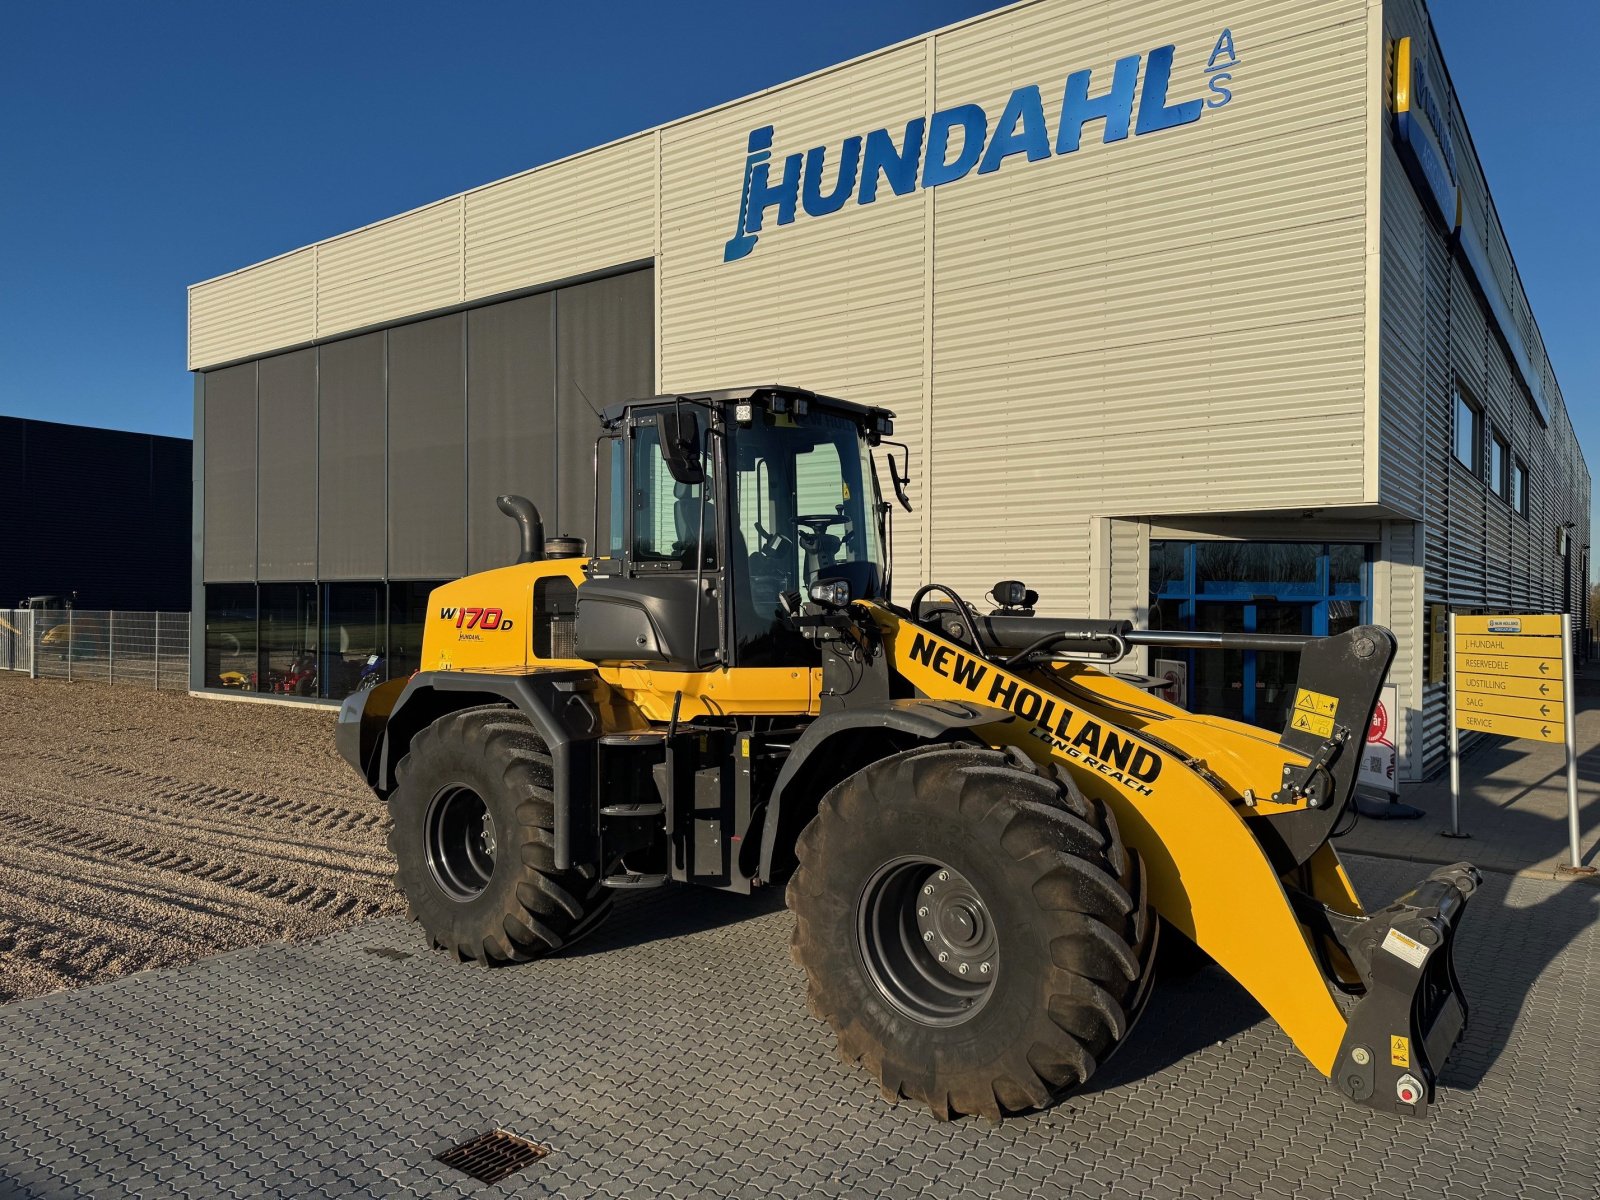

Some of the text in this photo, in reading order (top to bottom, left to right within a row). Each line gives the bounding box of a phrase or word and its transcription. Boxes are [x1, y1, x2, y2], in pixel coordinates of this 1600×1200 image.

[1465, 659, 1509, 669] RESERVEDELE
[1466, 679, 1506, 690] UDSTILLING
[1466, 698, 1484, 707] SALG
[909, 633, 1163, 784] NEW HOLLAND
[1466, 717, 1492, 728] SERVICE
[1028, 727, 1154, 797] LONG REACH
